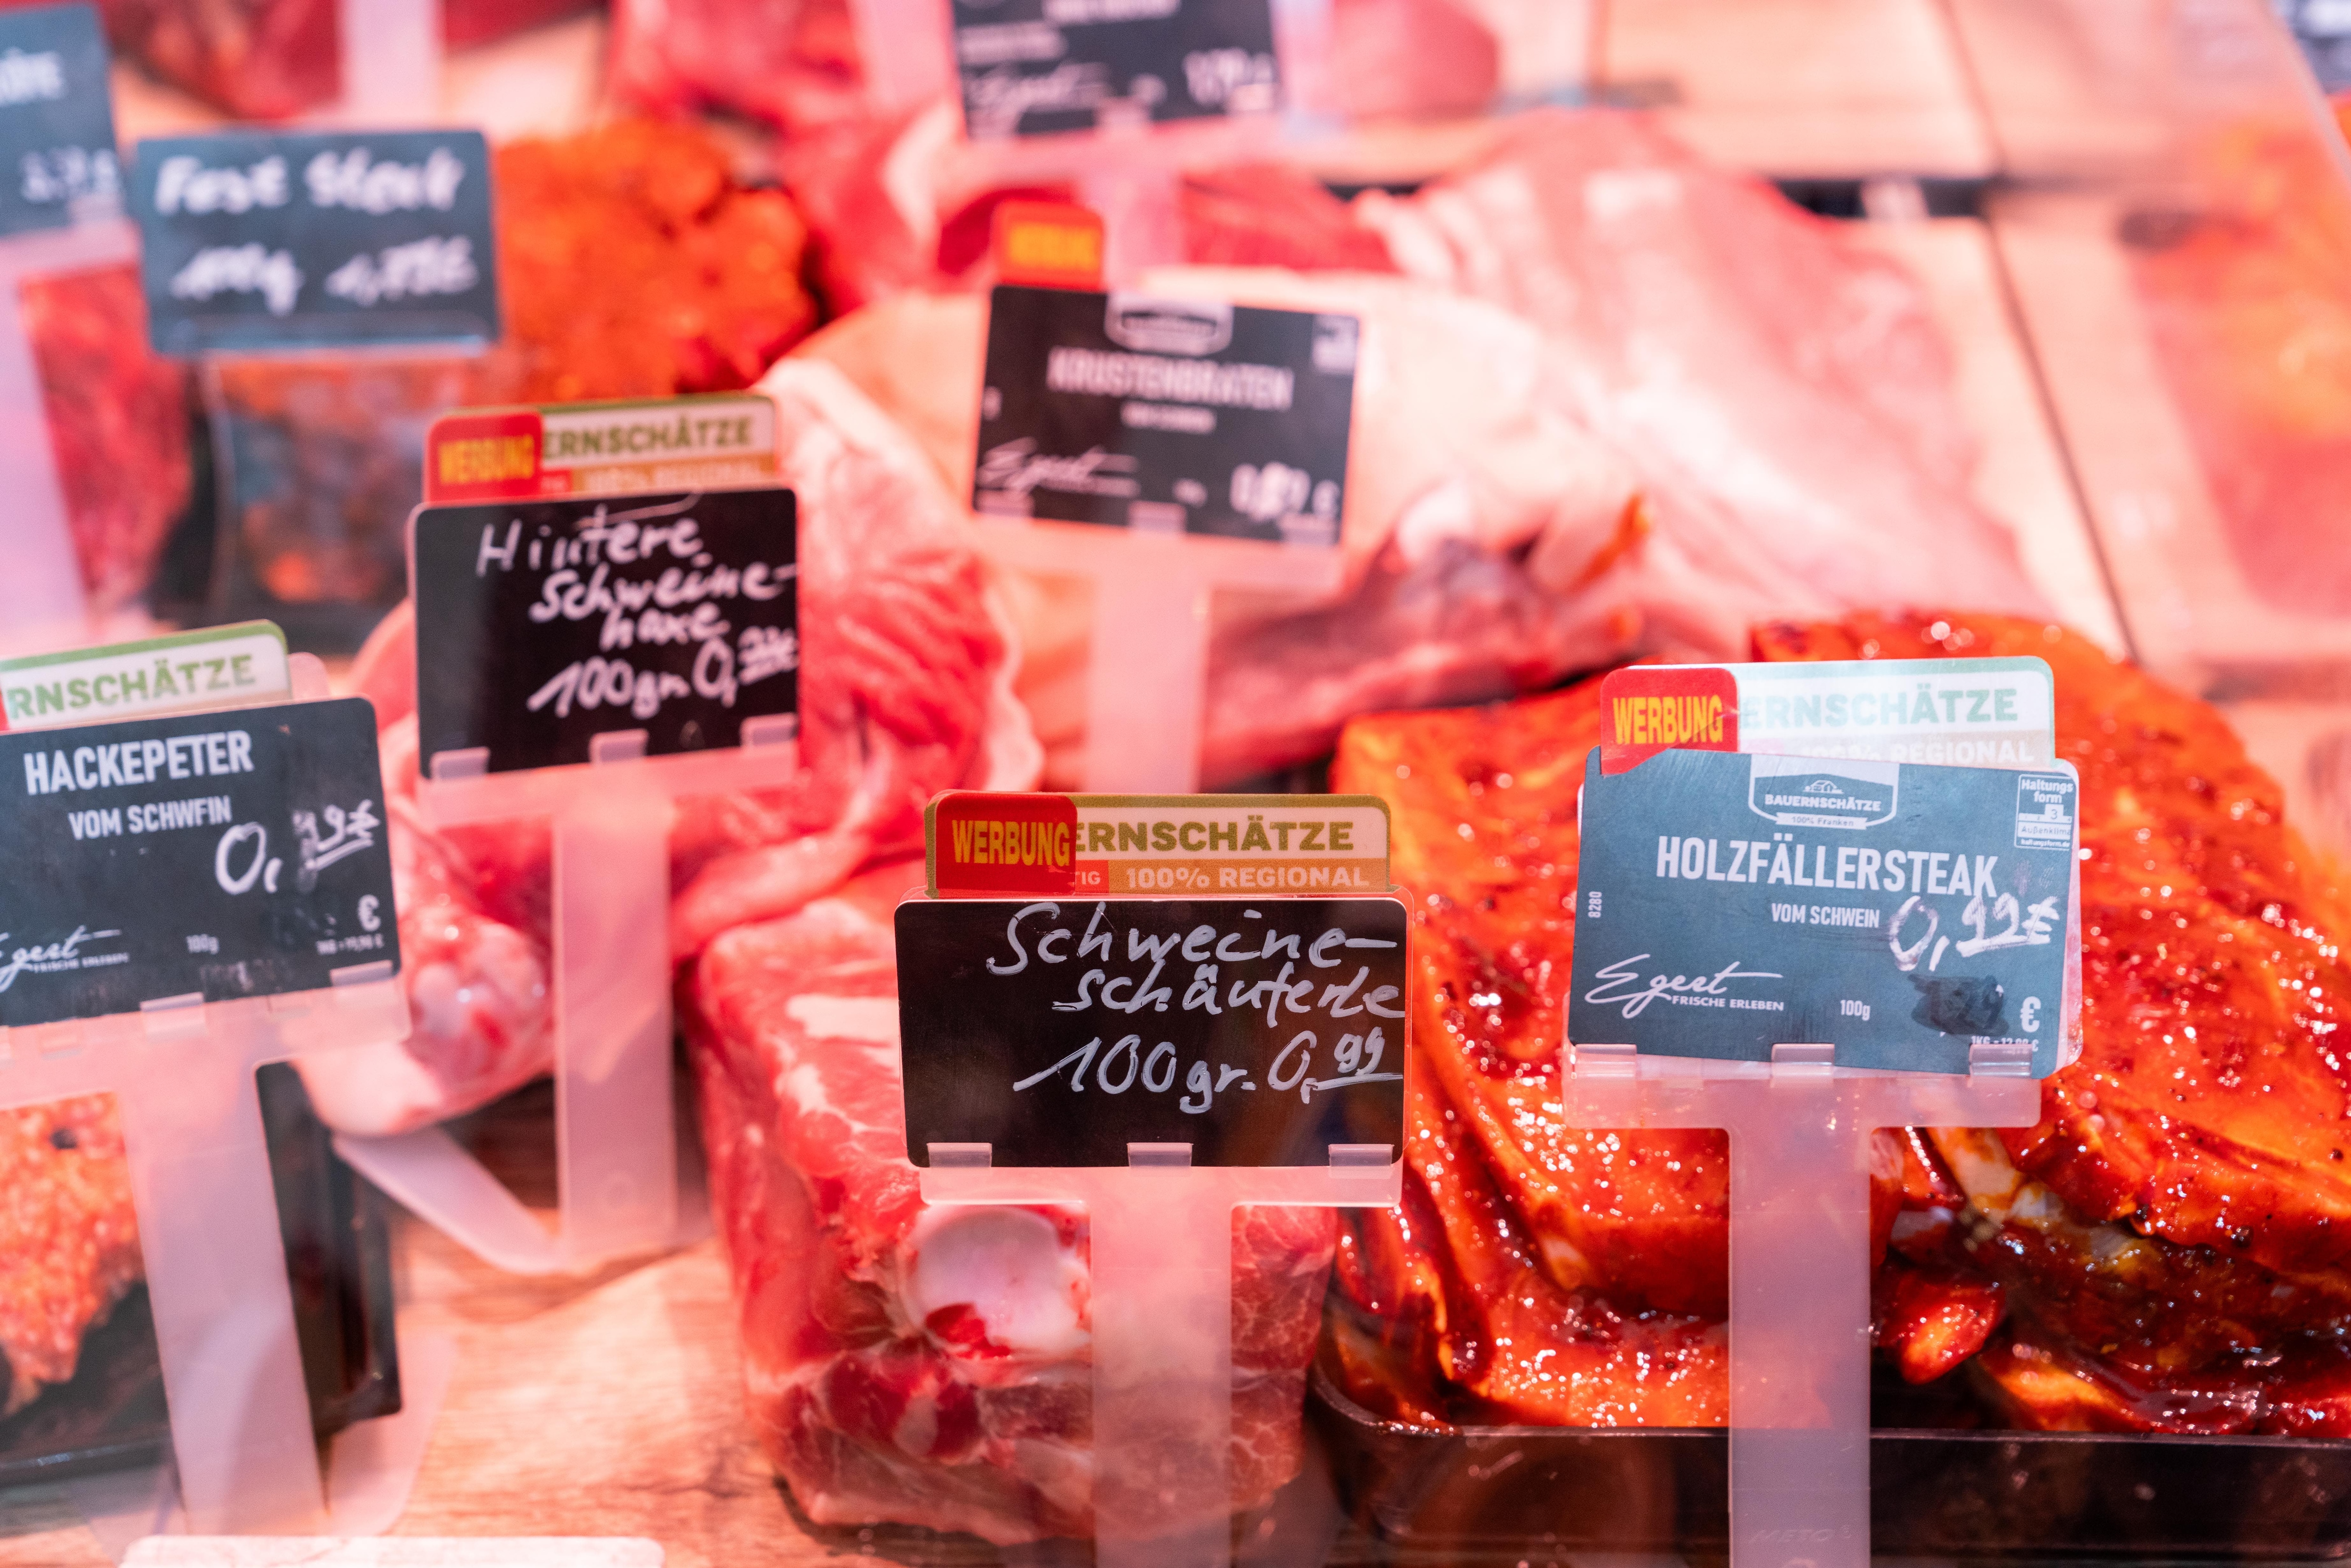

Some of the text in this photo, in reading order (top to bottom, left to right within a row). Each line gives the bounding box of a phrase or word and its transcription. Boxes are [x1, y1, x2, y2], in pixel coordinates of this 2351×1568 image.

[1046, 347, 1294, 411] KRUSTENBRATEN
[601, 602, 731, 653] haxe
[1613, 695, 1723, 745] WERBUNG
[24, 729, 255, 796] HACKEPETER
[1889, 740, 2035, 764] REGIONAL
[2021, 779, 2074, 795] Haltungs
[2034, 790, 2062, 804] form
[1764, 794, 1881, 812] BAUERNSCHÄTZE
[2051, 808, 2058, 819] 3
[68, 808, 123, 841] VOM
[1817, 817, 1854, 826] Franken
[951, 819, 1070, 867] WERBUNG
[1127, 866, 1370, 889] 100% REGIONAL
[1656, 832, 1999, 898] HOLZFÄLLERSTEAK
[357, 894, 381, 932] €
[1588, 890, 1602, 919] 8280
[1771, 902, 1880, 929] VOM SCHWEIN
[186, 934, 220, 955] 100g
[1672, 994, 1784, 1011] FRISCHE ERLEBEN
[1840, 999, 1871, 1021] 100g
[2020, 996, 2041, 1033] €
